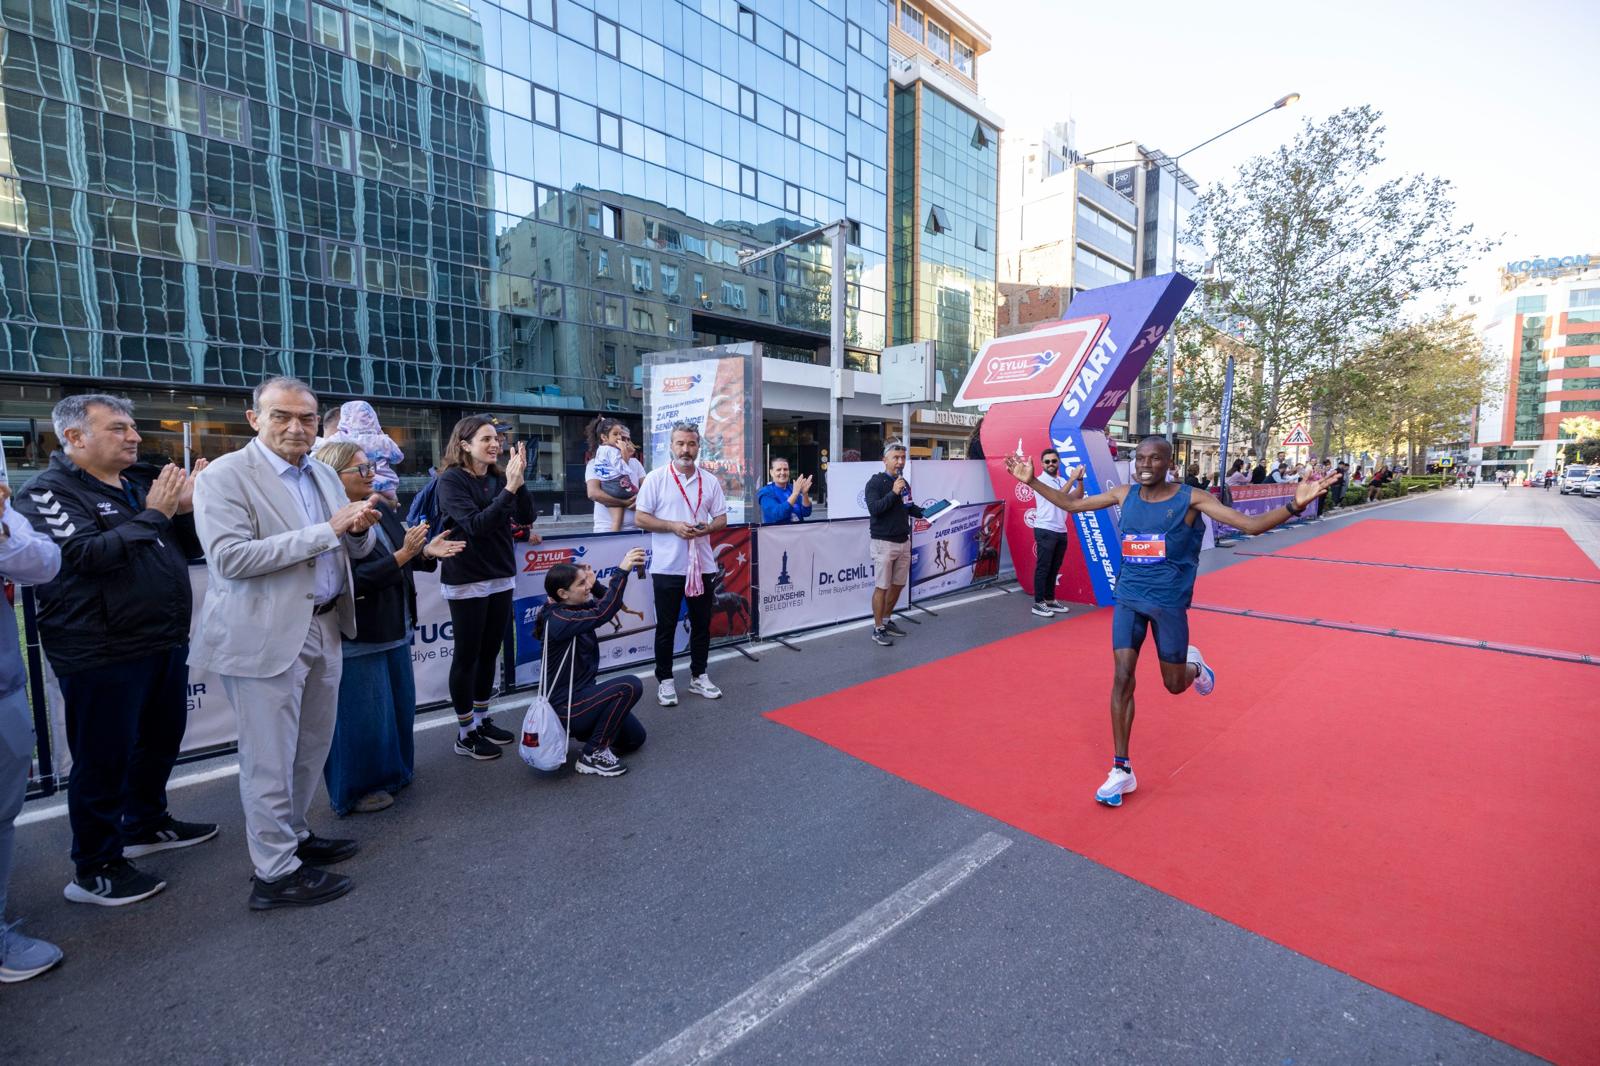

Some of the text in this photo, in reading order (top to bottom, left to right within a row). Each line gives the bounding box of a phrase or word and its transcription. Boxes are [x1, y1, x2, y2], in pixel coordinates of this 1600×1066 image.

[1507, 254, 1590, 273] KORDON
[1062, 327, 1118, 417] START
[1096, 390, 1127, 407] 21K
[1092, 529, 1108, 558] SENİN
[819, 572, 834, 586] Dr.
[837, 563, 868, 583] CEMİL
